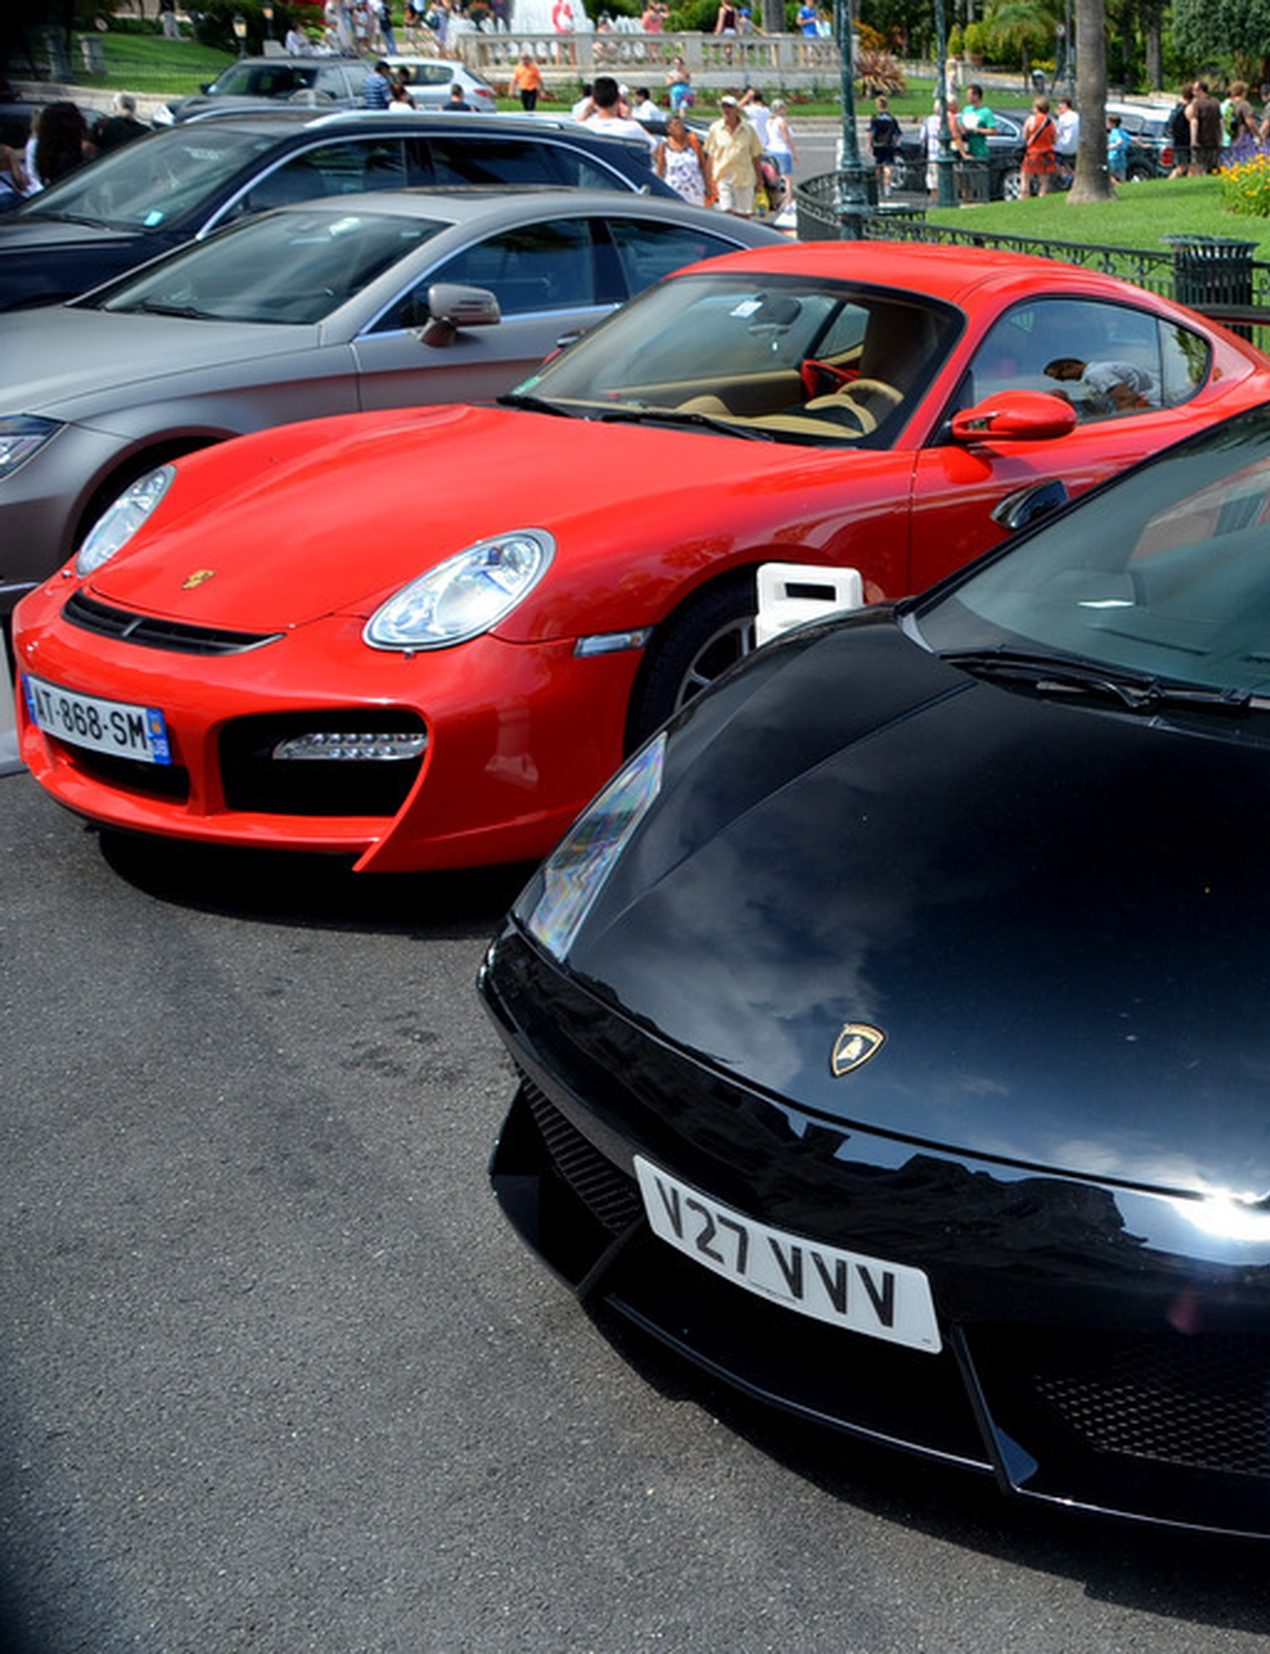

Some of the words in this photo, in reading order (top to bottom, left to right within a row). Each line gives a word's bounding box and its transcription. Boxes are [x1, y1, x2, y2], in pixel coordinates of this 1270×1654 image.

[34, 687, 148, 749] AT-868-SM
[655, 1176, 749, 1275] V27
[767, 1236, 895, 1328] VVV
